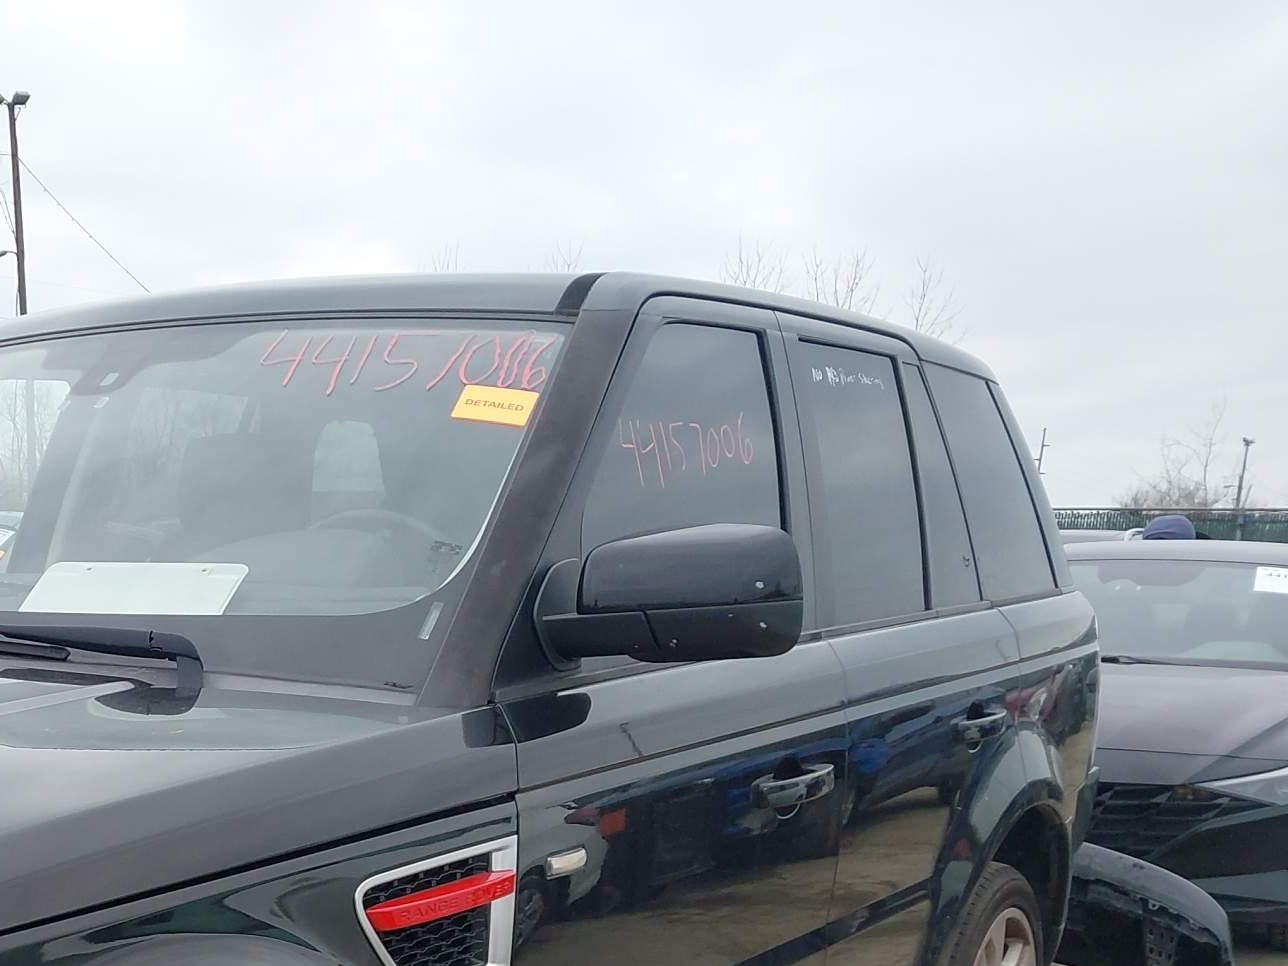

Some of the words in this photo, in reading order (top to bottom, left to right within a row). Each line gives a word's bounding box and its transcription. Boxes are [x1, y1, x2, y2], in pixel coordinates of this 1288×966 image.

[464, 397, 525, 412] DETAILED
[618, 410, 754, 489] 44157006
[399, 897, 459, 921] RANGE
